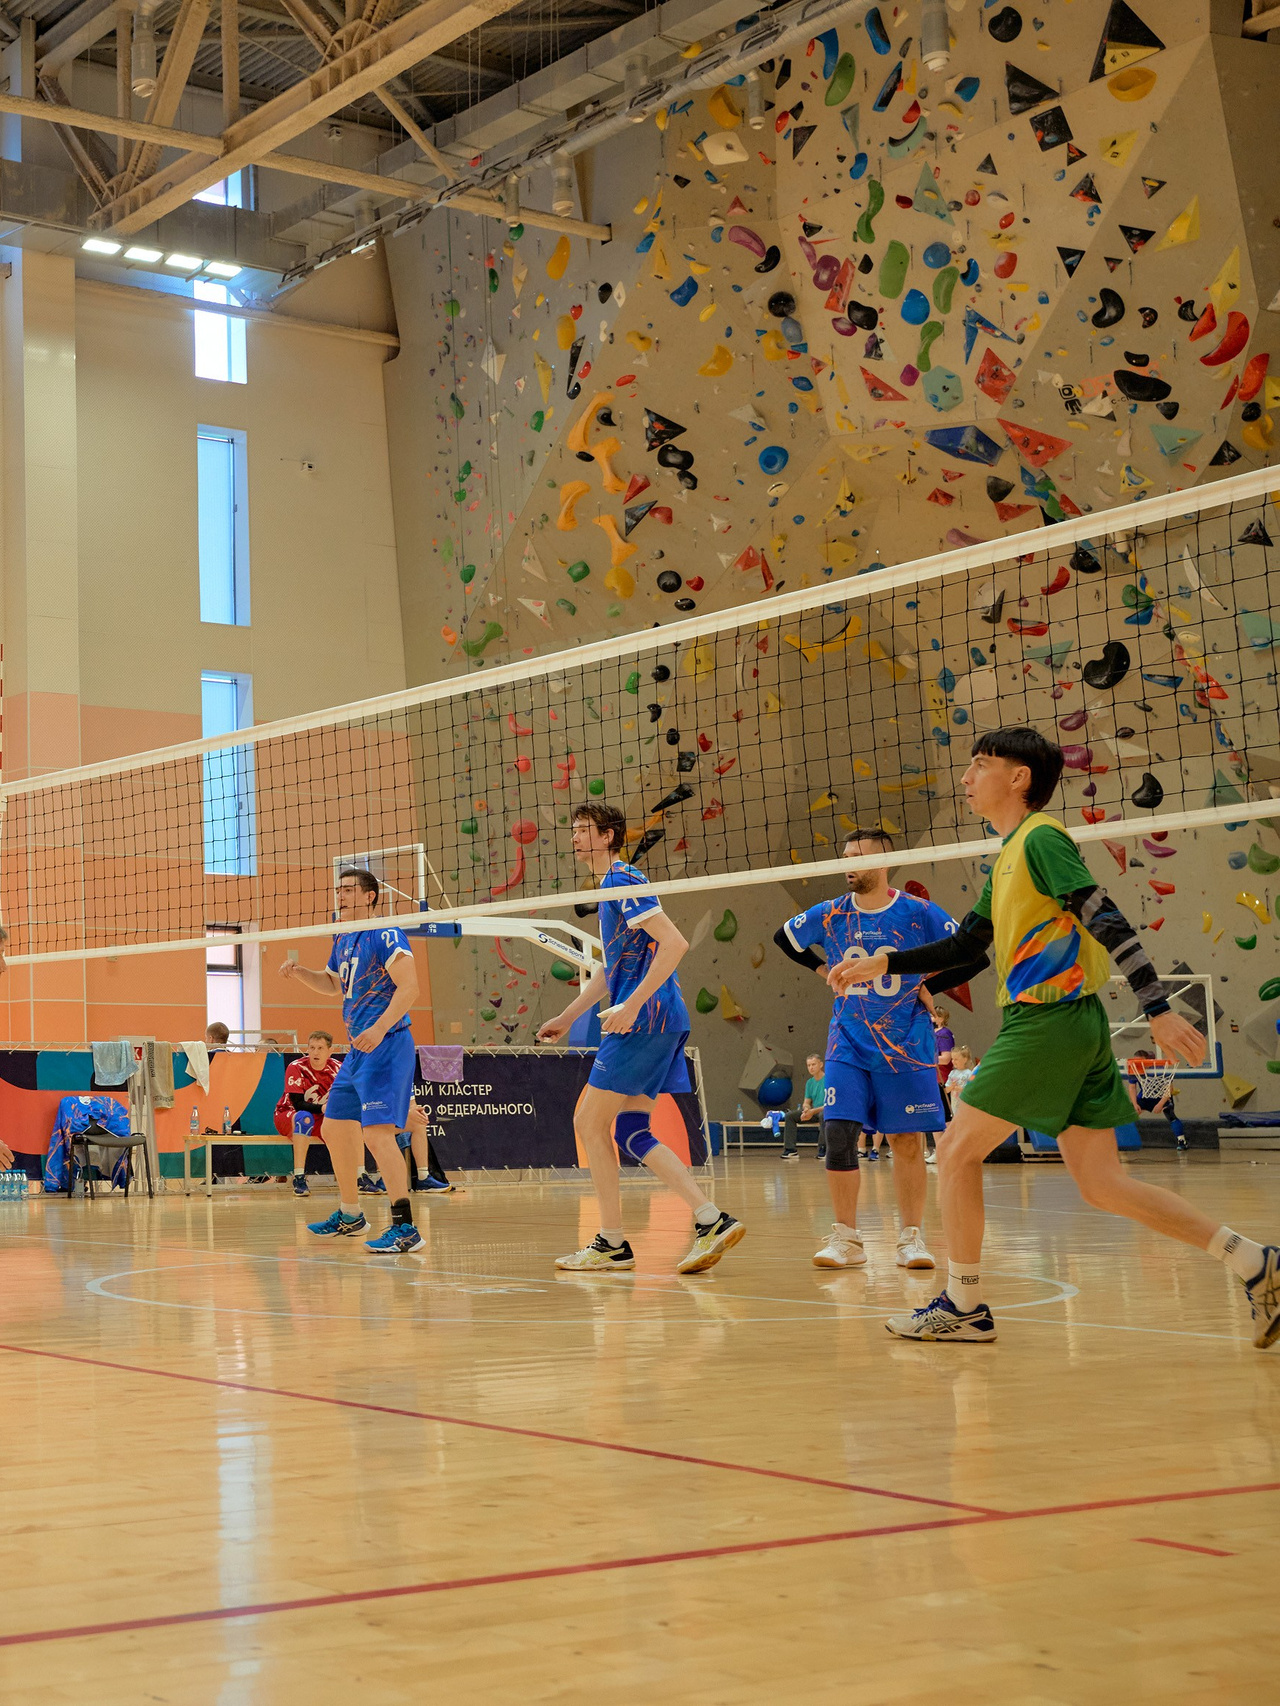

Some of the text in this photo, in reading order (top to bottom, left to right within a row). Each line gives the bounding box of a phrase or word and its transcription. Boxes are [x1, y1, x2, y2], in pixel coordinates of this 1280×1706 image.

[381, 929, 399, 949] 27
[287, 1075, 302, 1087] 64
[413, 1081, 493, 1096] ЫЙ КЛАСТЕР
[436, 1103, 533, 1117] ФЕДЕРАЛЬНОГО
[426, 1125, 447, 1137] ЕТА
